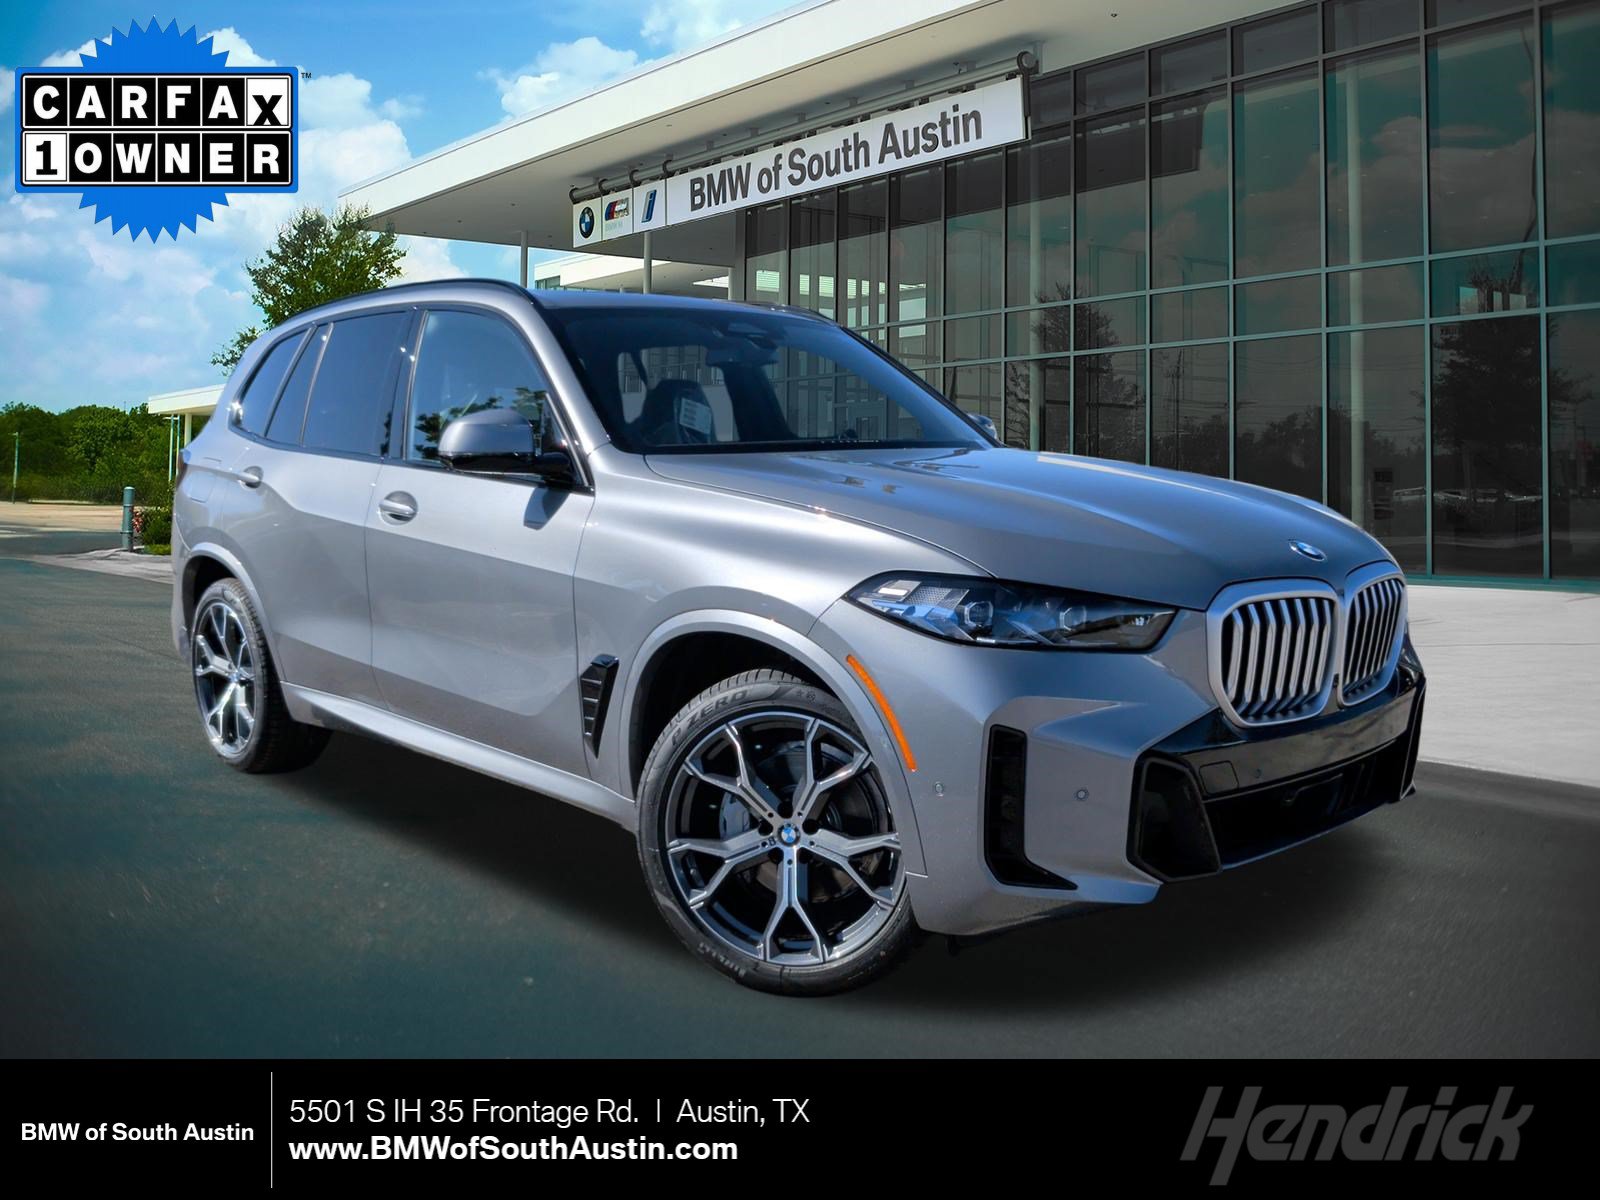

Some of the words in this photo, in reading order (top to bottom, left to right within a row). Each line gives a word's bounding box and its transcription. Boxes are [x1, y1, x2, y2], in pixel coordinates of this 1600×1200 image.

[689, 162, 752, 212] BMW
[757, 153, 783, 194] of
[787, 131, 871, 187] South
[878, 103, 983, 165] Austin
